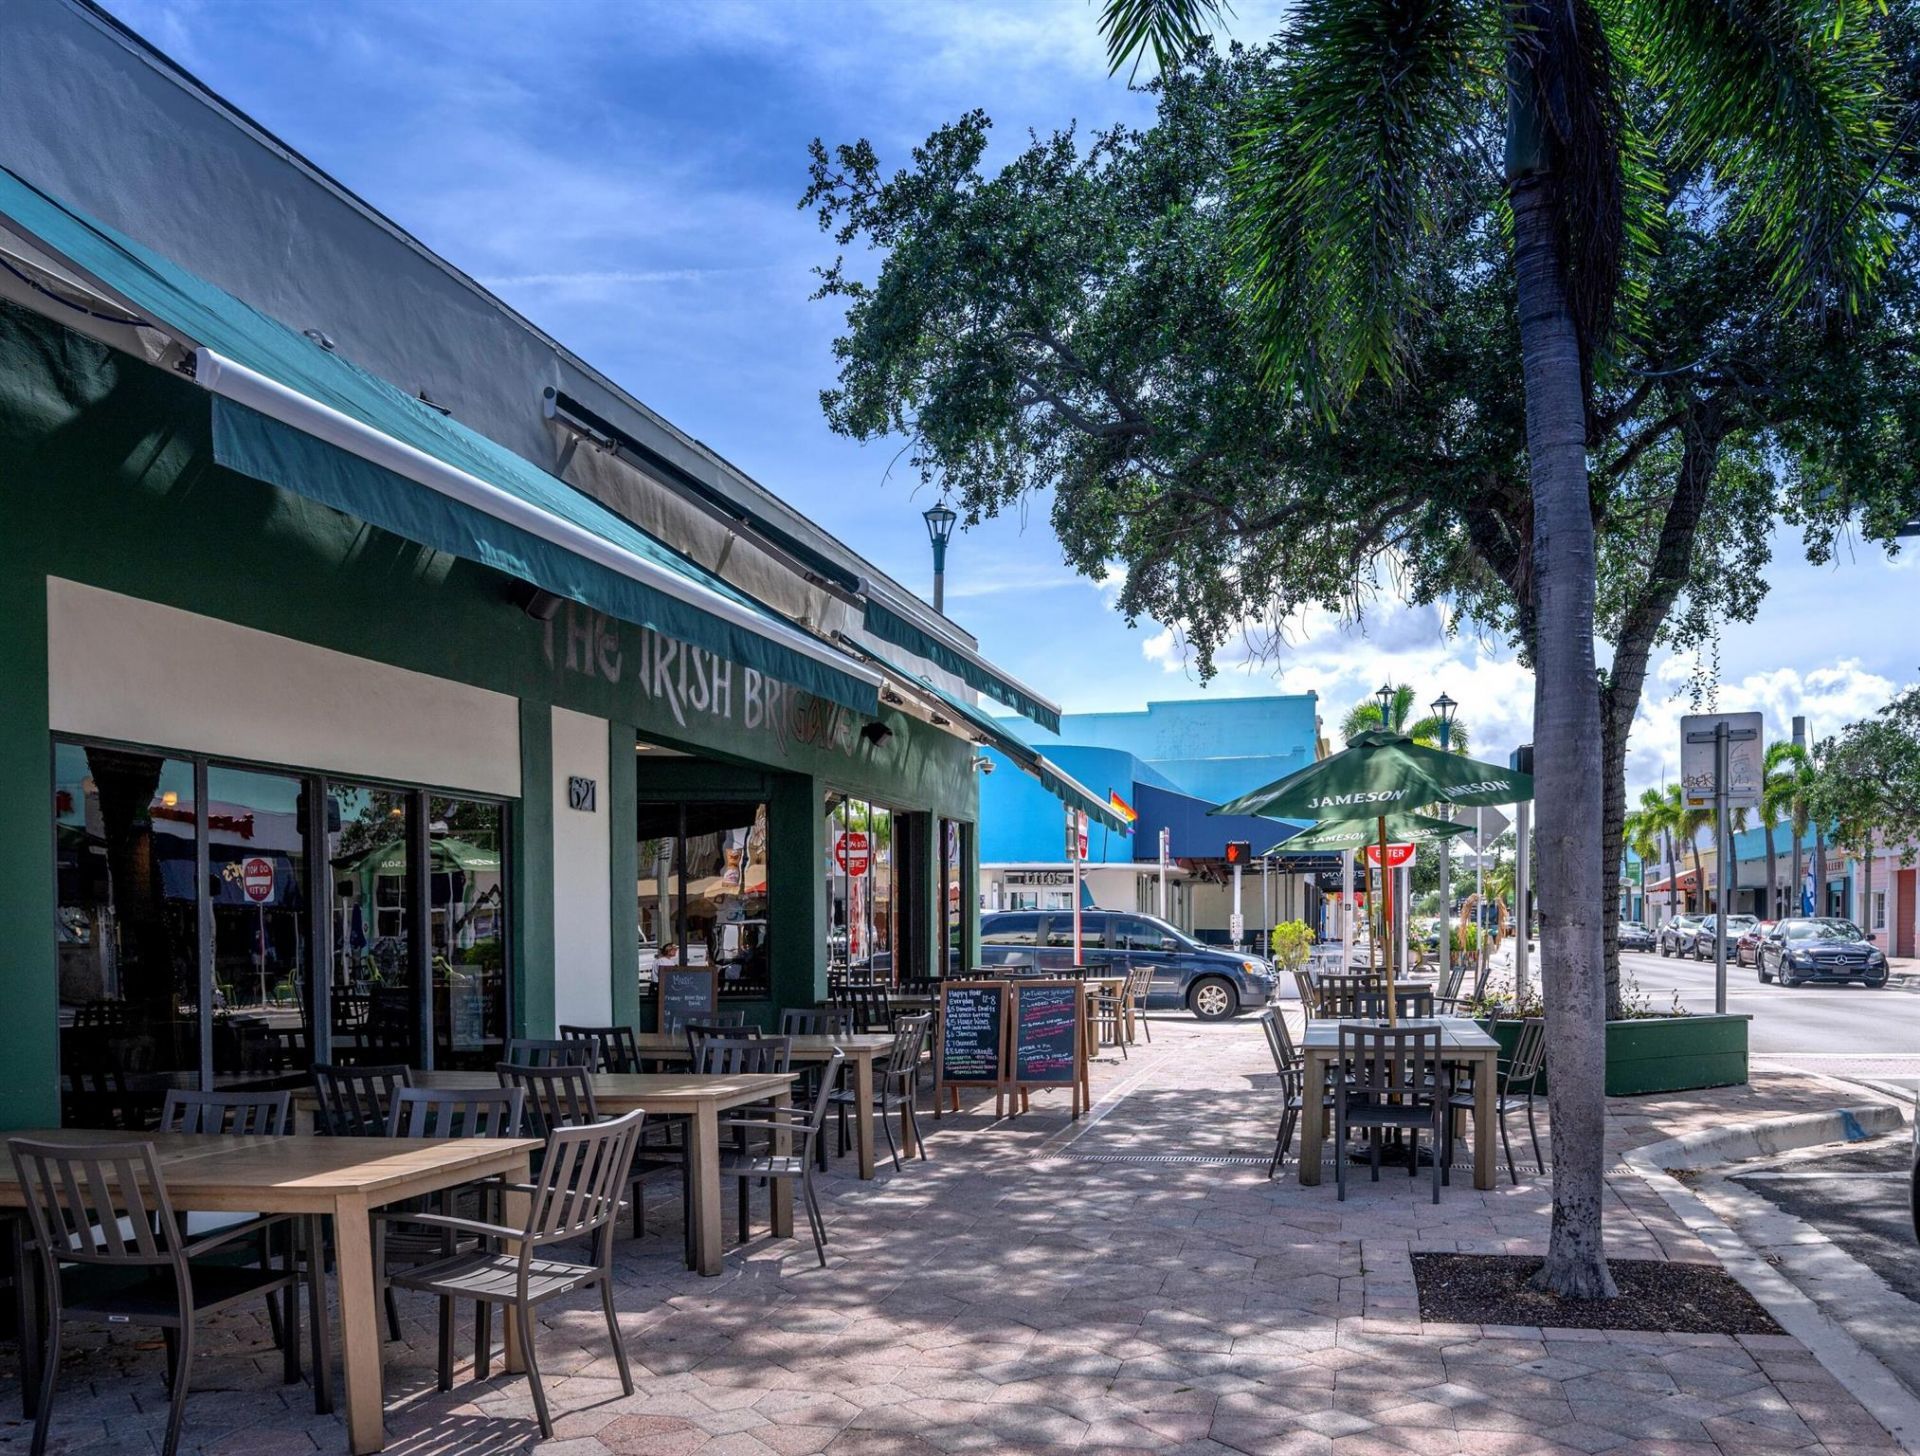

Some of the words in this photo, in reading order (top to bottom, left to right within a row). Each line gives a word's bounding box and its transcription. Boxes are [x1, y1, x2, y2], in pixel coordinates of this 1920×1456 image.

[639, 627, 731, 728] IRISH
[569, 776, 597, 812] 621
[1307, 789, 1410, 809] JAMESON
[1308, 831, 1368, 844] JAMESON
[1376, 850, 1404, 858] ETER
